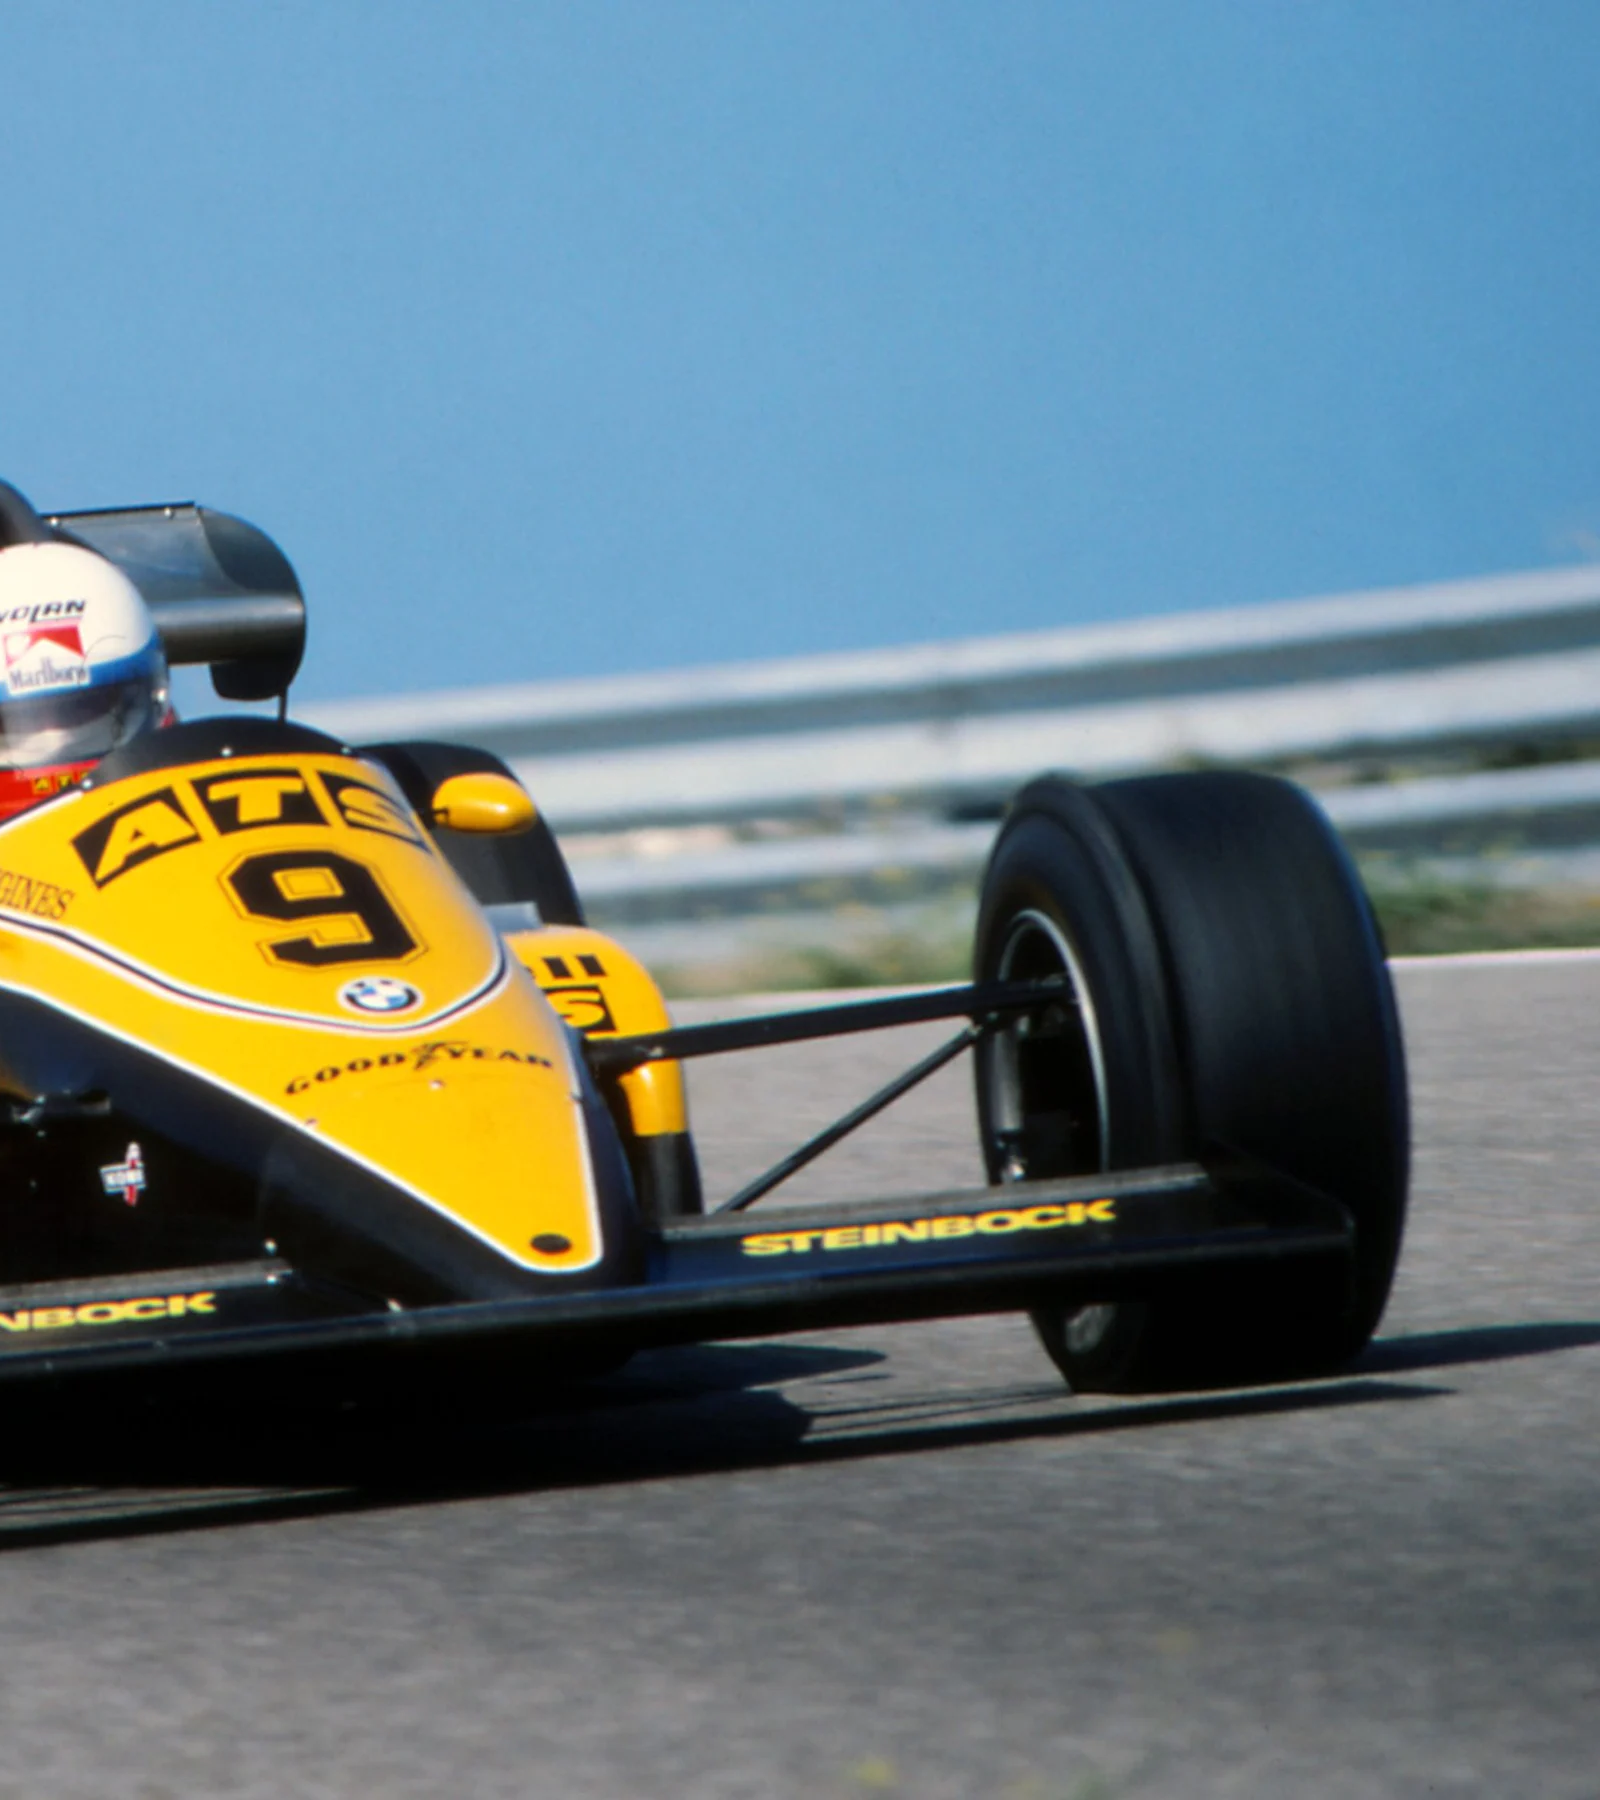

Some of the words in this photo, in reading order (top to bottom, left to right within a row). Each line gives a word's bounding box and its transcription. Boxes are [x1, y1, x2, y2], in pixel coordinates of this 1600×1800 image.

[10, 656, 87, 690] Marlboro
[94, 777, 420, 883] ATS
[222, 848, 425, 968] 9
[741, 1199, 1116, 1256] STEINBOCK
